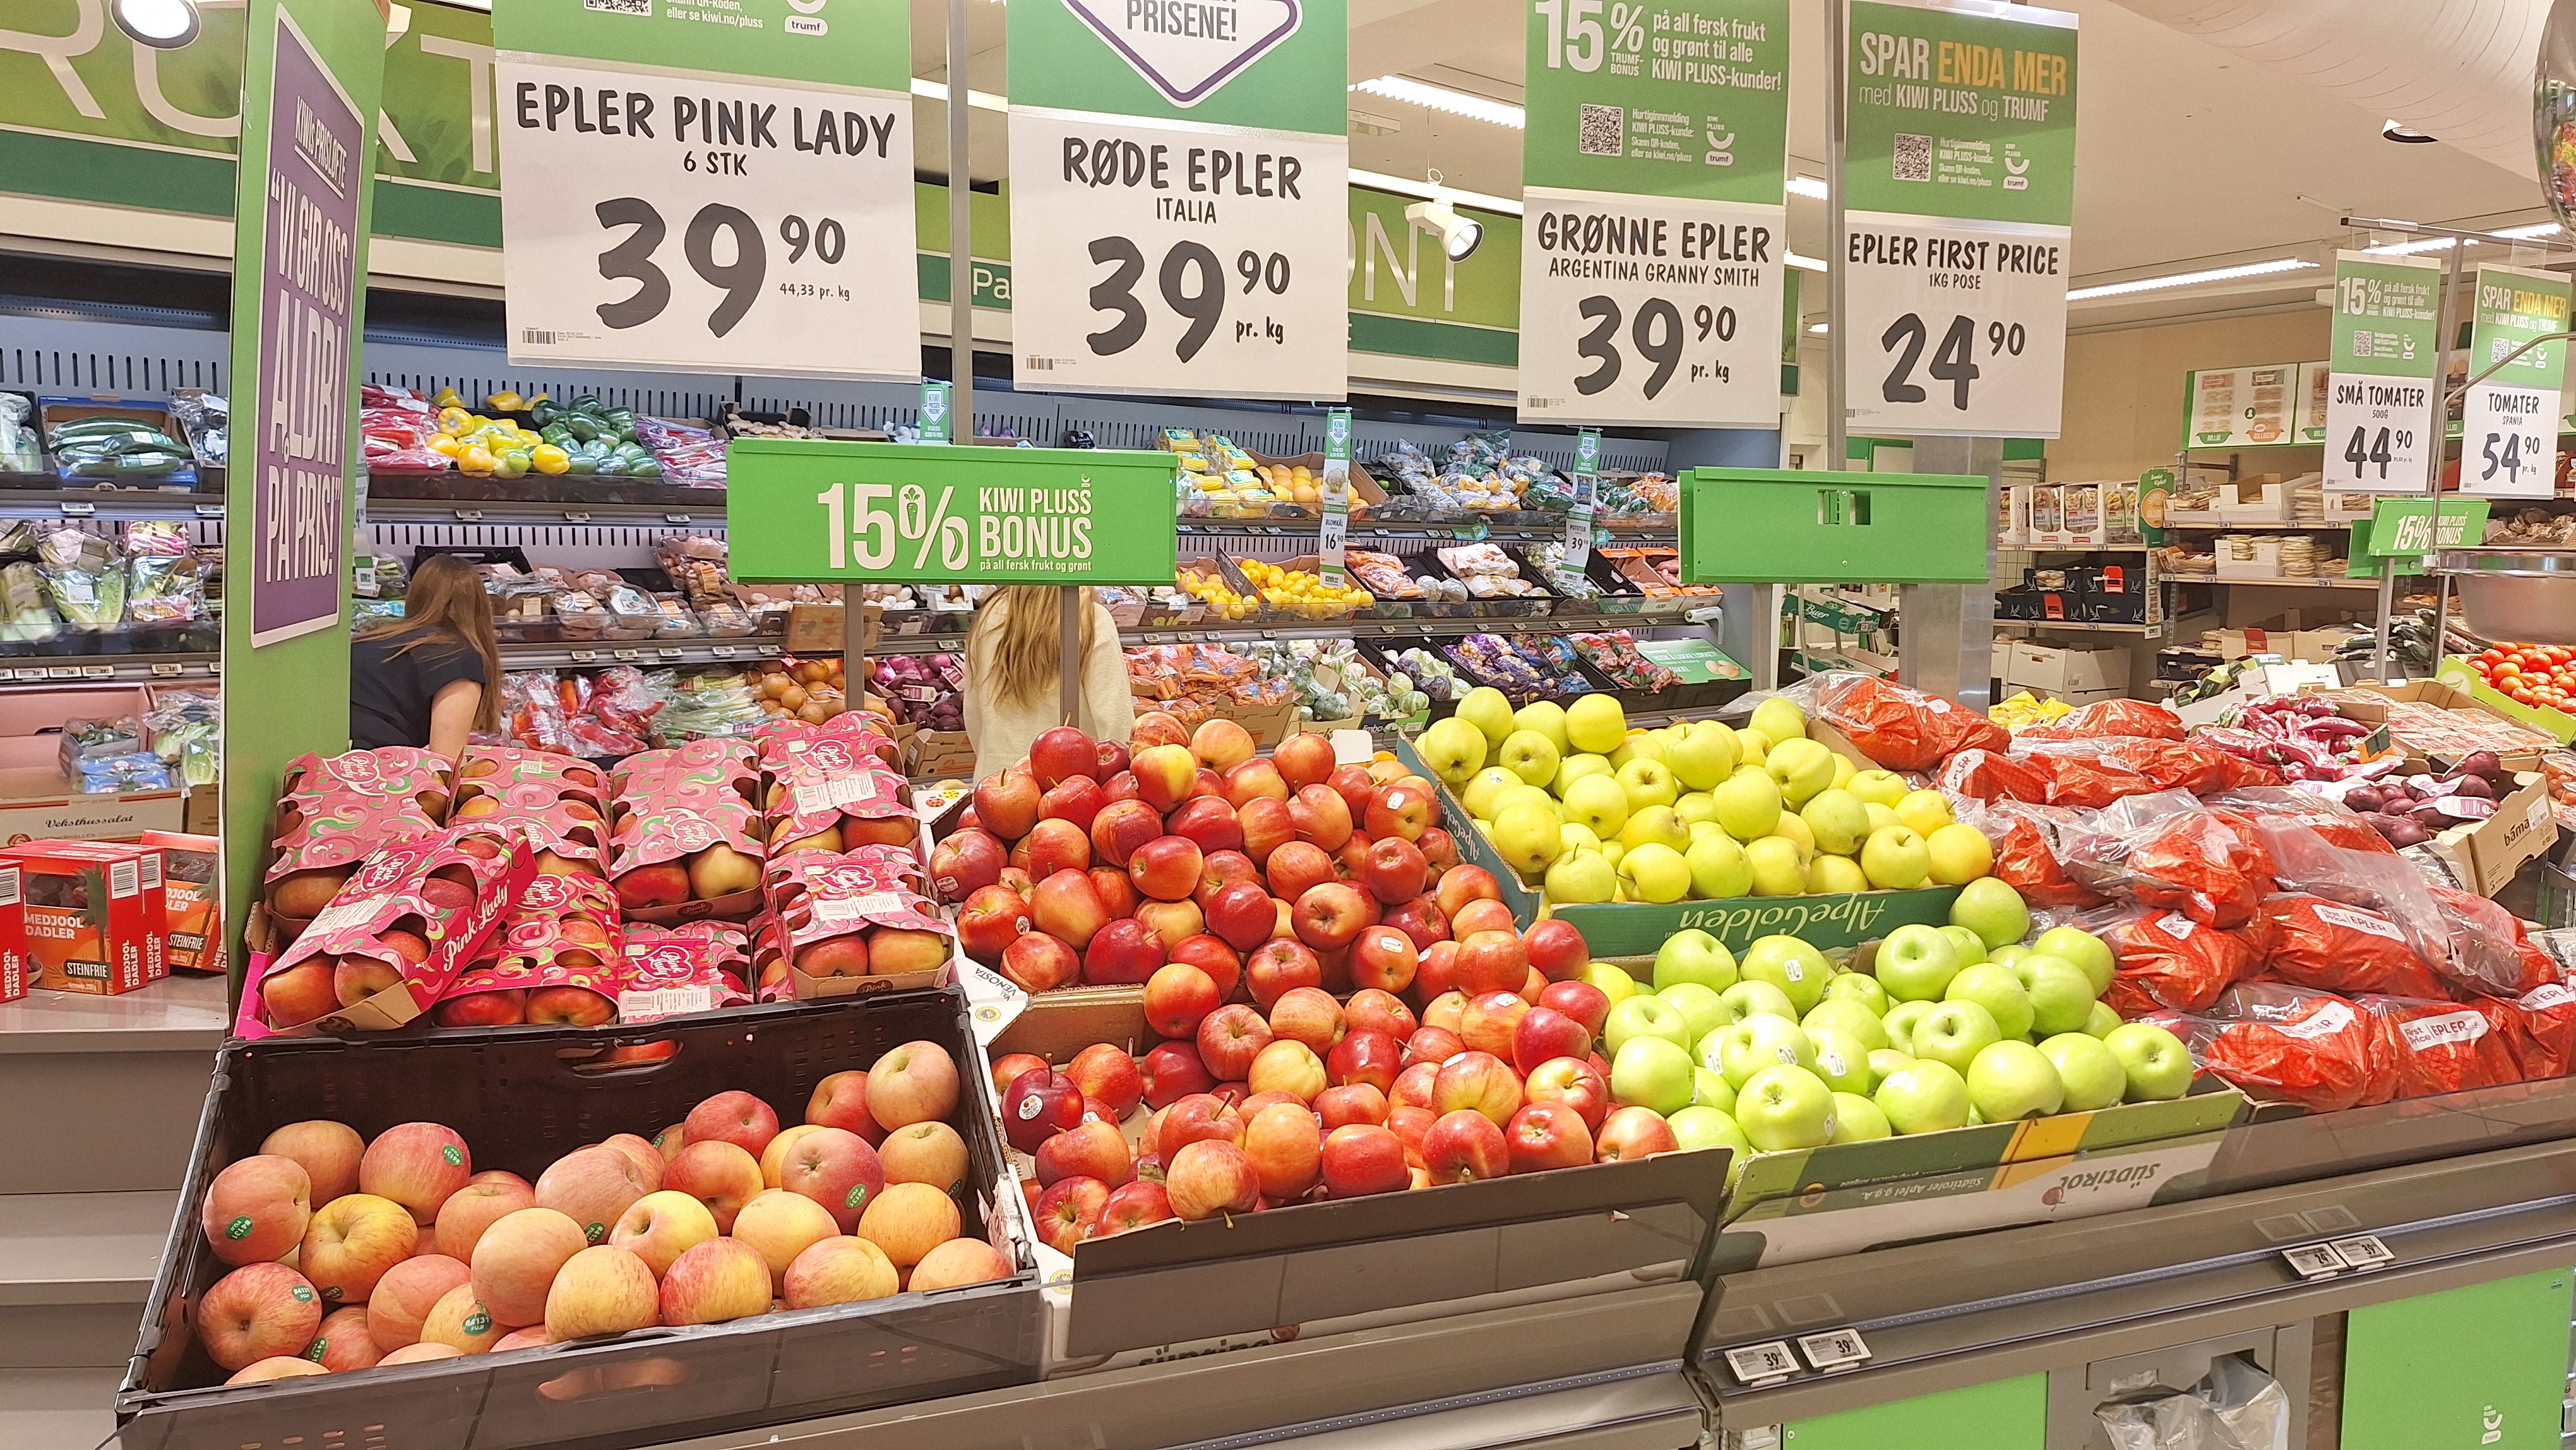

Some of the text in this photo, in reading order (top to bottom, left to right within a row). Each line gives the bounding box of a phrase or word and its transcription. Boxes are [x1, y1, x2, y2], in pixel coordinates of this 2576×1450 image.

[667, 8, 763, 29] eller se kiwi.no/pluss
[791, 20, 821, 32] trumf
[1126, 0, 1237, 42] PRISENE!
[1654, 9, 1766, 42] på all fersk frukt
[1535, 0, 1645, 73] 15%
[1610, 52, 1644, 65] TRUMF-
[1652, 37, 1753, 62] og grønt til alle
[1611, 65, 1640, 76] BONUS
[1652, 58, 1782, 92] KIWI PLUSS-kunder!
[1860, 32, 2067, 96] SPAR ENDA MER
[1859, 83, 2049, 122] med KIWI PLUSS og TRUMF
[516, 82, 895, 159] EPLER PINK LADY
[1631, 122, 1647, 133] KIWI
[1632, 109, 1690, 126] Hurtiginnmelding
[295, 95, 347, 189] KIWIs PRISLØFTE
[1631, 137, 1649, 147] Skann
[1631, 149, 1644, 159] eller
[683, 150, 748, 177] 6 STK
[1709, 154, 1729, 163] trumf
[1940, 150, 1953, 160] KIWI
[1063, 136, 1302, 201] RØDE EPLER
[1156, 197, 1217, 224] ITALIA
[1537, 212, 1770, 263] GRØNNE EPLER
[297, 195, 322, 299] GIR
[322, 219, 349, 316] OSS
[1849, 232, 2059, 275] EPLER FIRST PRICE
[595, 197, 846, 339] 39 90
[1549, 257, 1760, 287] ARGENTINA GRANNY SMITH
[779, 282, 850, 302] 44,33 pr. kg
[1929, 272, 1981, 291] 1KG POSE
[1086, 236, 1225, 364] 39
[1237, 249, 1291, 295] 90
[2339, 277, 2382, 315] 15%
[2482, 285, 2567, 319] SPAR ENDA MER
[2383, 306, 2395, 317] KIWI
[2481, 312, 2558, 333] med KIWI PLUSS og TRUMF
[1236, 316, 1284, 344] pr. kg
[1573, 294, 1736, 401] 39 90
[1691, 360, 1729, 383] pr. kg
[1881, 312, 2025, 411] 24 90
[270, 289, 342, 465] ALDRI
[2337, 380, 2424, 408] SMÅ TOMATER
[2489, 393, 2539, 415] TOMATER
[2372, 409, 2388, 419] 500G
[2502, 416, 2522, 426] SPANIA
[2344, 425, 2413, 480] 44 90
[2482, 433, 2540, 484] 54 90
[2531, 464, 2537, 476] kg
[266, 436, 290, 582] PÅ
[979, 488, 1091, 515] KIWI PLUSS
[818, 482, 969, 571] 15%
[1325, 518, 1343, 527] BLOMKÅL
[1570, 524, 1587, 532] POTETER
[2450, 516, 2467, 526] PLUSS
[979, 515, 1092, 559] BONUS
[1325, 534, 1344, 550] 16 90
[1571, 537, 1583, 550] 39
[980, 558, 1092, 573] på all fersk frukt og grønt
[1804, 604, 1829, 620] Buer
[339, 755, 374, 779] Pink Lady
[811, 745, 848, 770] Pink Lady
[45, 814, 134, 829] Veksthussalat
[25, 914, 84, 929] MEDJOOL
[443, 879, 511, 972] Pink Lady
[1679, 892, 1886, 942] AlpeGolden
[2351, 916, 2387, 932] EPLER
[25, 927, 76, 939] DADLER
[168, 934, 204, 950] STEINFRIE
[122, 940, 131, 988] MEDJOOL
[131, 945, 139, 986] DADLER
[146, 931, 155, 978] MEDJOOL
[154, 937, 162, 976] DADLER
[648, 951, 688, 976] Pink Lady
[67, 962, 108, 978] STEINFRIE
[975, 967, 1017, 1001] VAL VENOSTA
[2404, 1020, 2468, 1037] First EPLER
[2409, 1034, 2431, 1043] Price
[232, 1219, 253, 1240] #4131
[2315, 1254, 2329, 1264] 24
[2361, 1243, 2376, 1255] 39
[465, 1316, 489, 1326] #4131
[1835, 1339, 1850, 1353] 39
[1763, 1353, 1778, 1367] 39
